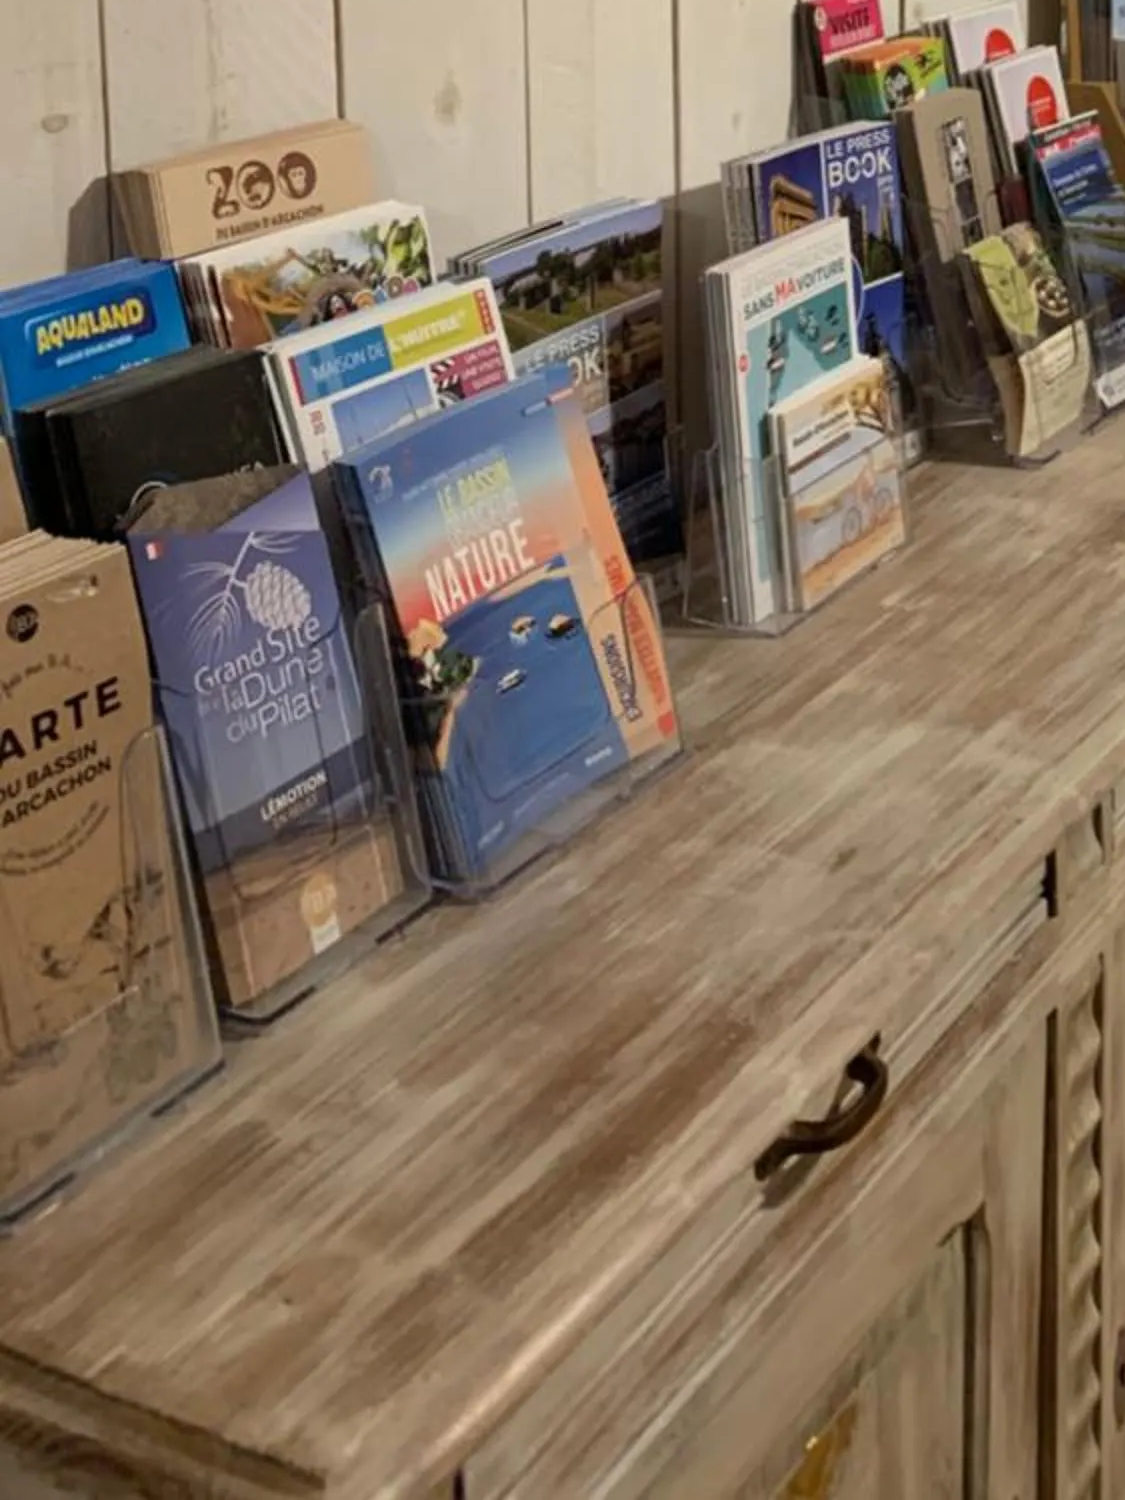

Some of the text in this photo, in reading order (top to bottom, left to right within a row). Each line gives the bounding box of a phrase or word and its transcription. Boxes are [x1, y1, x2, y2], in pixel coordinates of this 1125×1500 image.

[826, 129, 890, 159] LE PRESS
[828, 148, 893, 188] BOOK
[206, 151, 317, 219] ZOO
[744, 293, 775, 321] SANS
[775, 276, 797, 302] MA
[796, 257, 845, 293] VOITURE
[36, 297, 145, 356] AQUALAND
[527, 324, 600, 373] LE PRESS
[311, 346, 366, 382] MAISON
[366, 341, 386, 362] DE
[425, 518, 536, 622] NATURE
[194, 615, 321, 694] Grand Site
[222, 684, 244, 714] la
[227, 714, 257, 743] du
[257, 684, 321, 740] Pilat
[2, 755, 112, 829] ARCACHON
[26, 739, 98, 790] BASSIN
